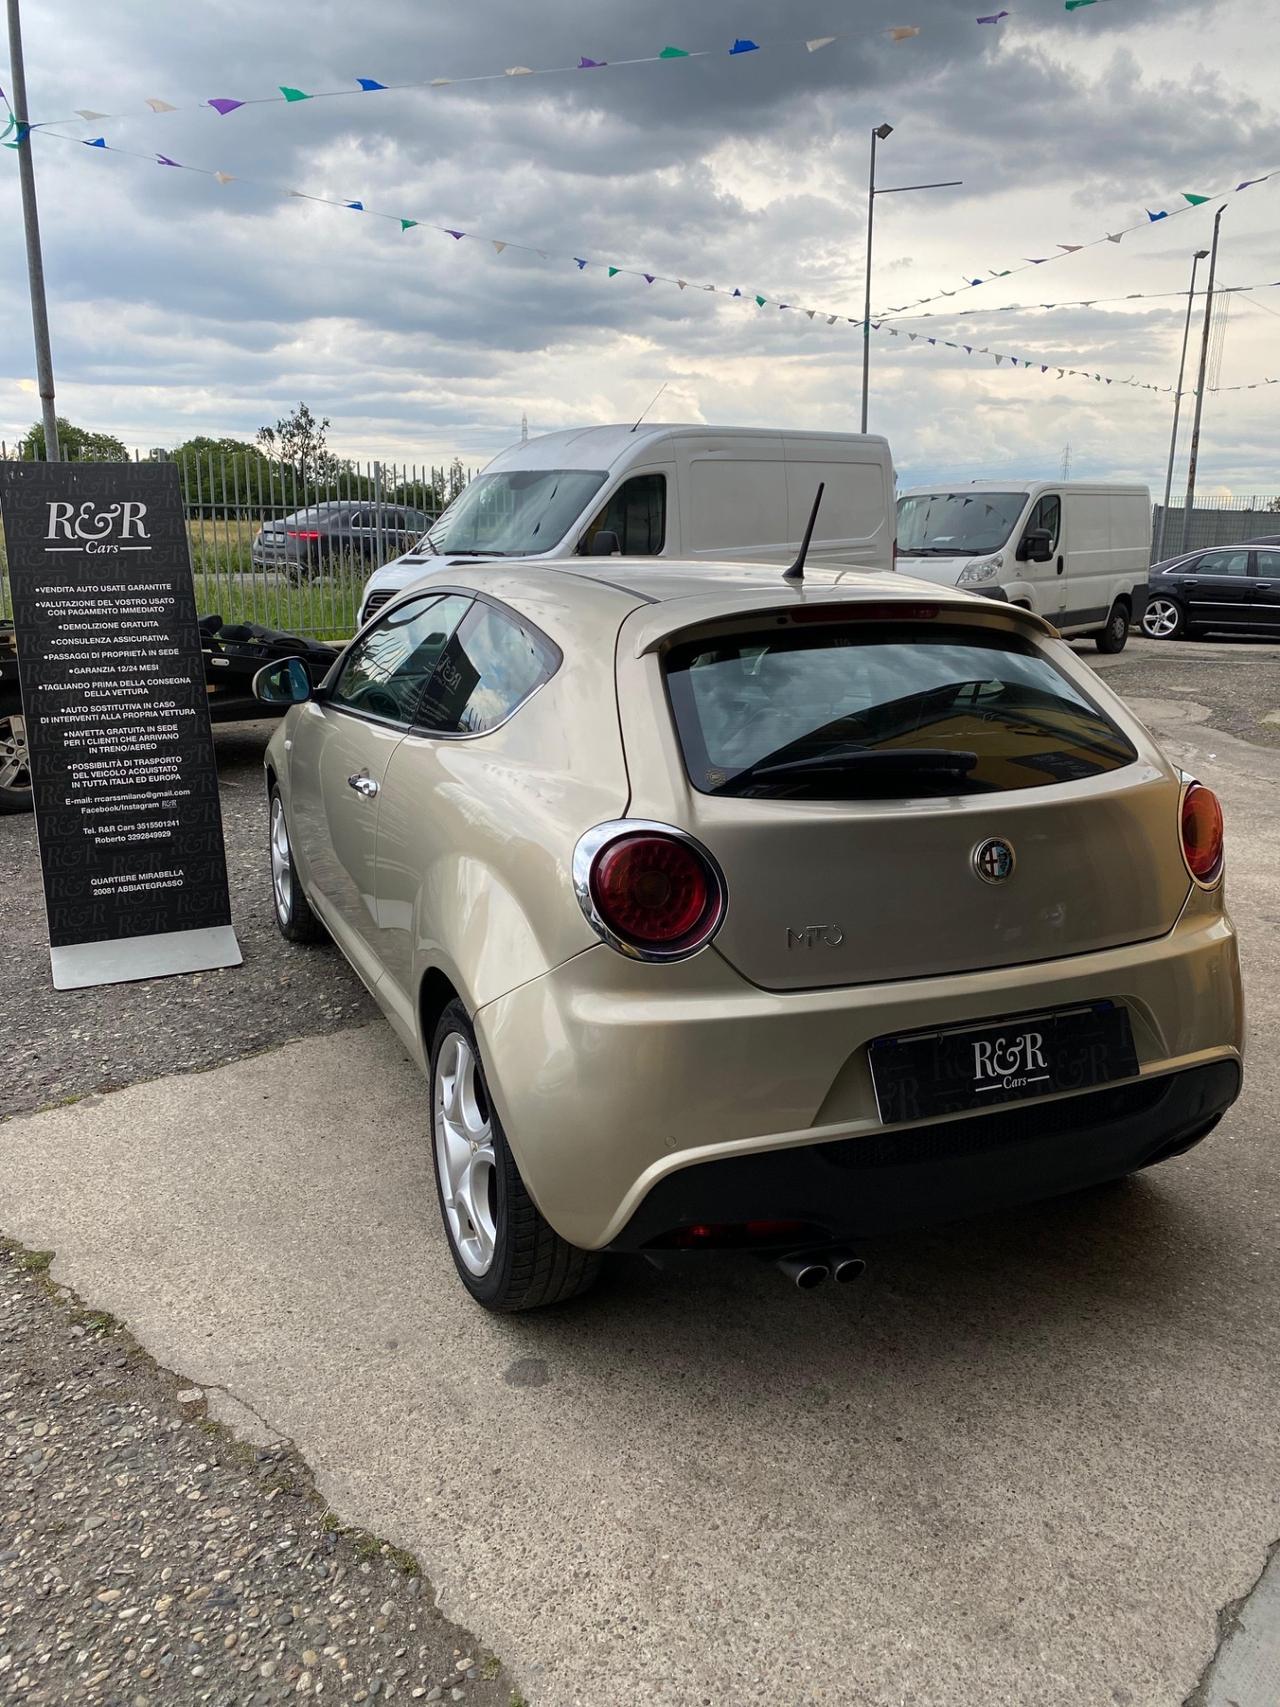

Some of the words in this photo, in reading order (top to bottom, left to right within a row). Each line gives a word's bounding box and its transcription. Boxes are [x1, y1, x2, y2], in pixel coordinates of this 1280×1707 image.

[43, 501, 151, 539] R&R
[85, 541, 119, 554] Cars
[100, 584, 126, 592] USATE
[127, 583, 172, 591] GARANTITE
[39, 599, 96, 609] VALUTAZIONE
[97, 599, 113, 607] DEL
[114, 598, 147, 607] VOSTRO
[148, 597, 174, 606] USATO
[67, 607, 118, 615] PAGAMENTO
[119, 606, 164, 614] IMMEDIATO
[62, 621, 119, 630] DEMOLIZIONE
[120, 620, 159, 628] GRATUITA
[55, 636, 111, 645] CONSULENZA
[112, 634, 169, 643] ASSICURATIVA
[48, 652, 89, 660] PASSAGGI
[73, 666, 116, 674] GARANZIA
[117, 664, 138, 672] 12/24
[42, 682, 90, 690] TAGLIANDO
[91, 680, 118, 688] PRIMA
[119, 679, 145, 688] DELLA
[146, 677, 191, 685] CONSEGNA
[84, 689, 110, 697] DELLA
[111, 687, 149, 696] VETTURA
[65, 705, 88, 713] AUTO
[90, 702, 142, 712] SOSTITUTIVA
[153, 700, 175, 710] CASO
[50, 714, 99, 723] INTERVENTI
[100, 712, 121, 720] ALLA
[122, 710, 158, 719] PROPRIA
[159, 708, 196, 716] VETTURA
[68, 729, 105, 737] NAVETTA
[106, 726, 145, 735] GRATUITA
[156, 723, 178, 733] SEDE
[86, 736, 118, 745] CLIENTI
[119, 735, 137, 743] CHE
[138, 732, 179, 743] ARRIVANO
[98, 743, 157, 753] TRENO/AEREO
[133, 756, 182, 766] TRASPORTO
[72, 771, 89, 779] DEL
[90, 768, 126, 778] VEICOLO
[128, 765, 178, 775] ACQUISTATO
[81, 779, 108, 787] TUTTA
[109, 777, 134, 785] ITALIA
[148, 773, 181, 782] EUROPA
[94, 835, 126, 844] Roberto
[90, 874, 136, 885] QUARTIERE
[138, 869, 184, 880] MIRABELLA
[117, 879, 183, 892] ABBIATEGRASSO
[971, 1032, 1048, 1080] R&R
[1003, 1075, 1028, 1089] Cars
